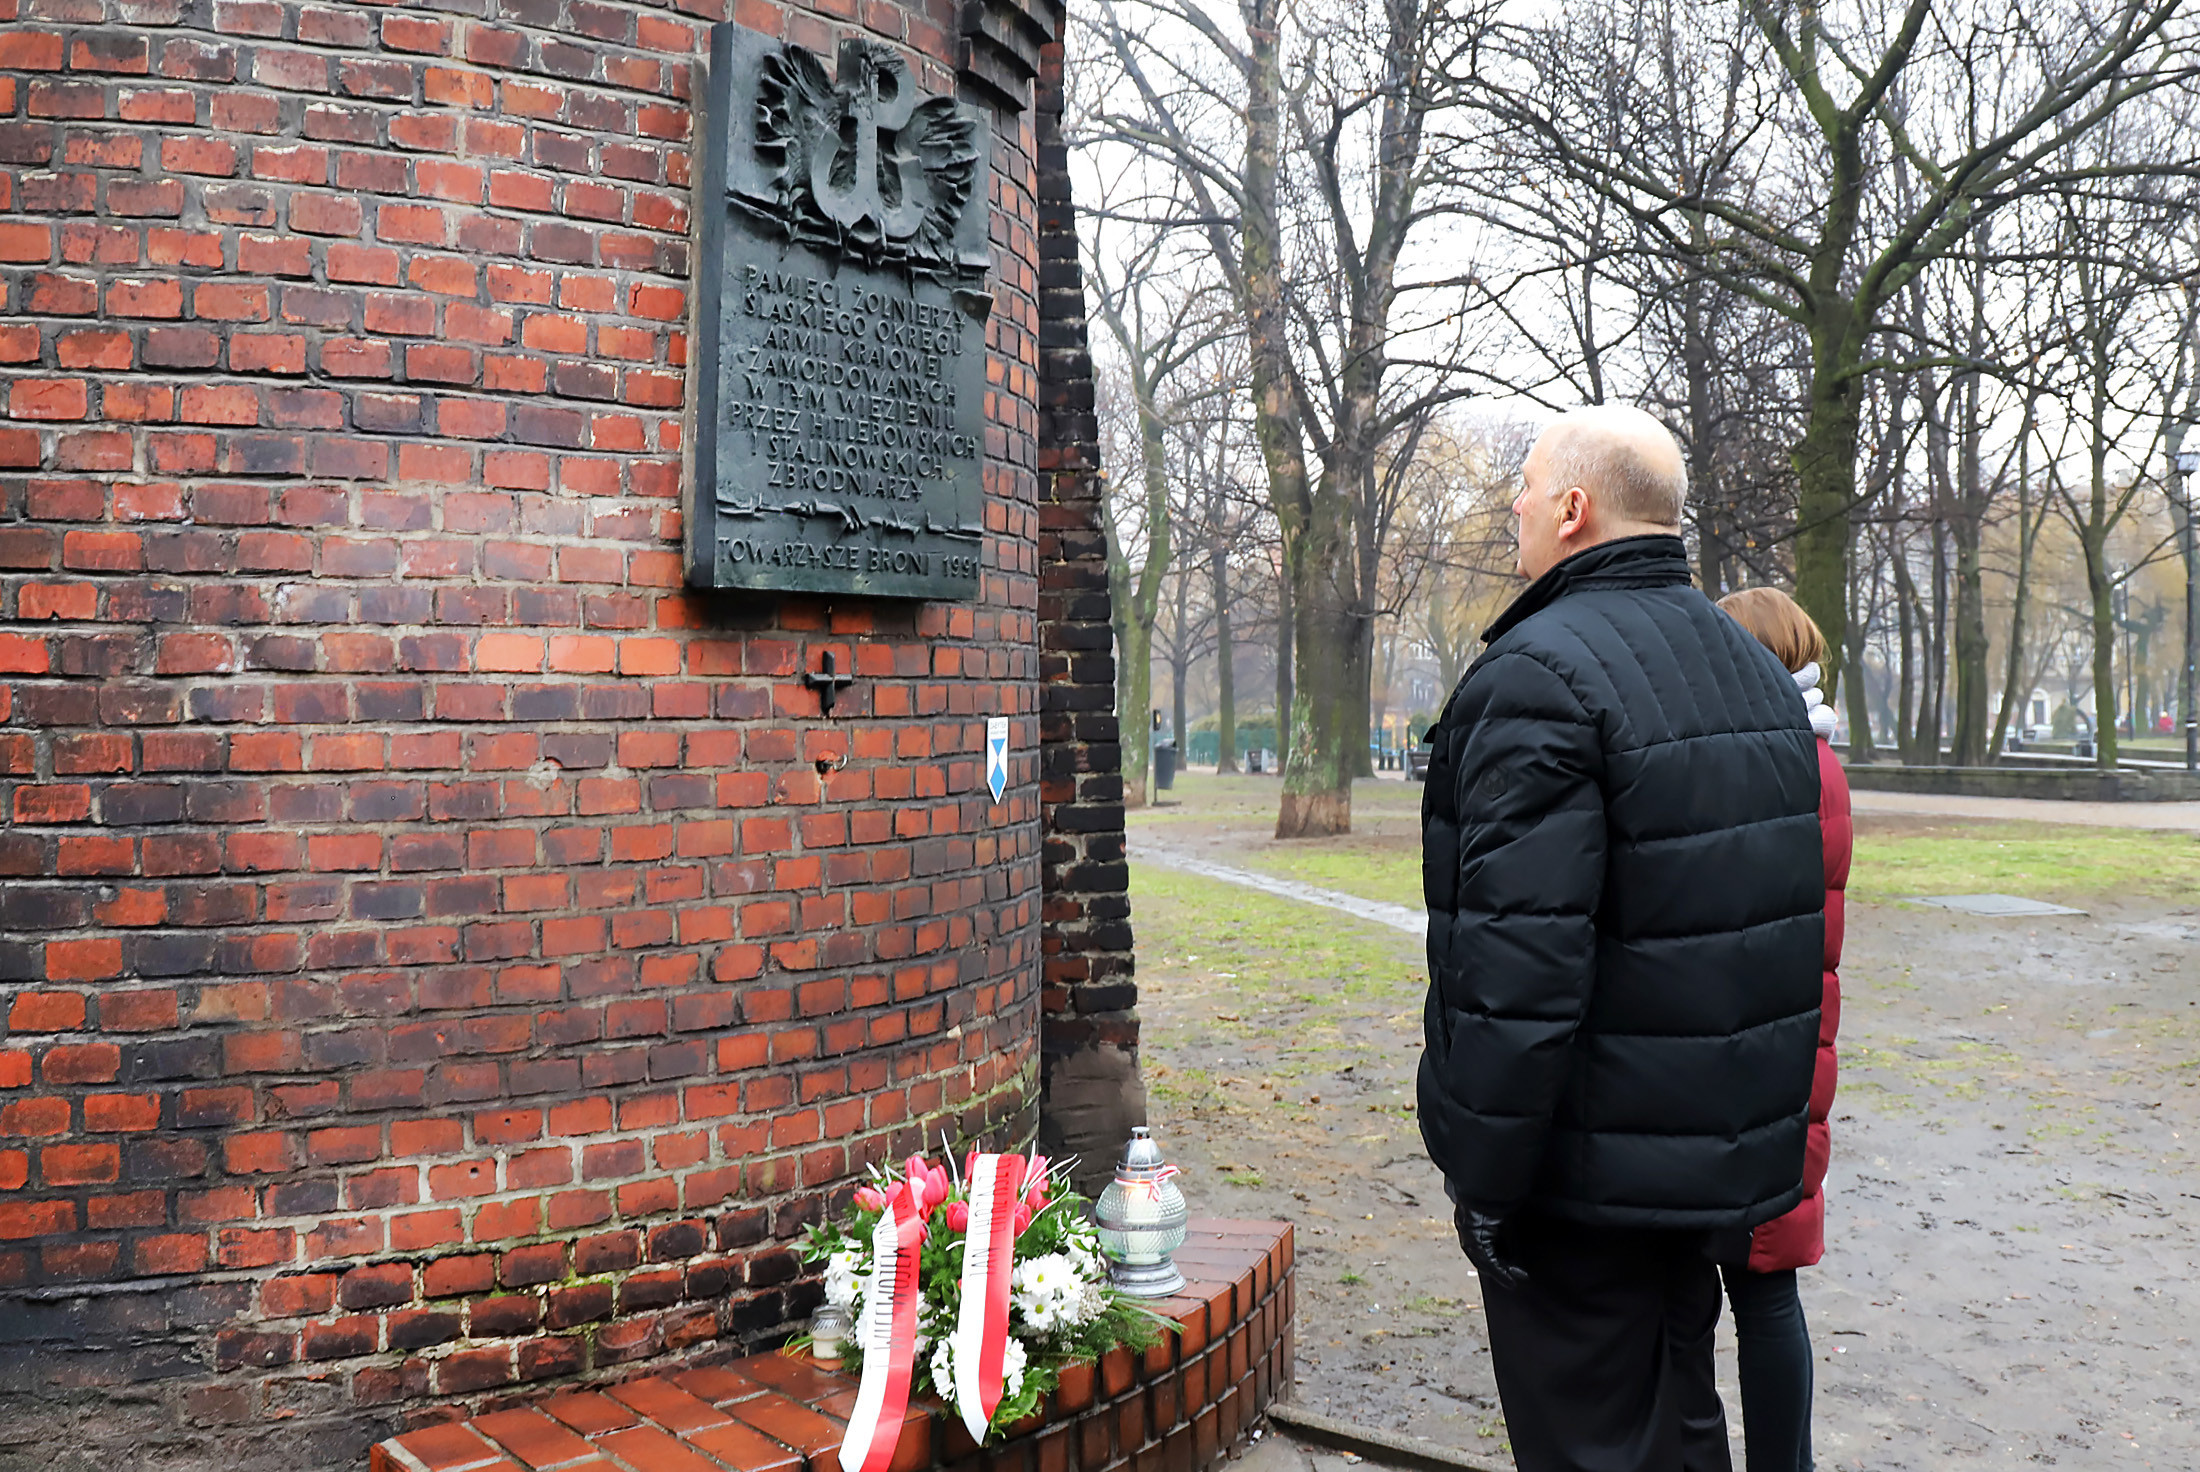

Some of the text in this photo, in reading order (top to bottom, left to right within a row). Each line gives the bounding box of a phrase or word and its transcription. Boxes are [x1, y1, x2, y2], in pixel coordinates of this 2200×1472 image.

[853, 284, 967, 334] ŻOŁNIERZY
[762, 325, 828, 357] ARMII
[742, 372, 770, 400] W
[778, 381, 826, 412] TYM
[749, 347, 956, 406] ZAMORDOWANYCH
[728, 402, 976, 458] PRZEZ HITLEROWSKICH
[767, 435, 943, 480] STALINOWSKICH
[768, 461, 924, 502] ZBRODNIARZY
[718, 537, 978, 579] TOWARZYSZE BRONI 1991
